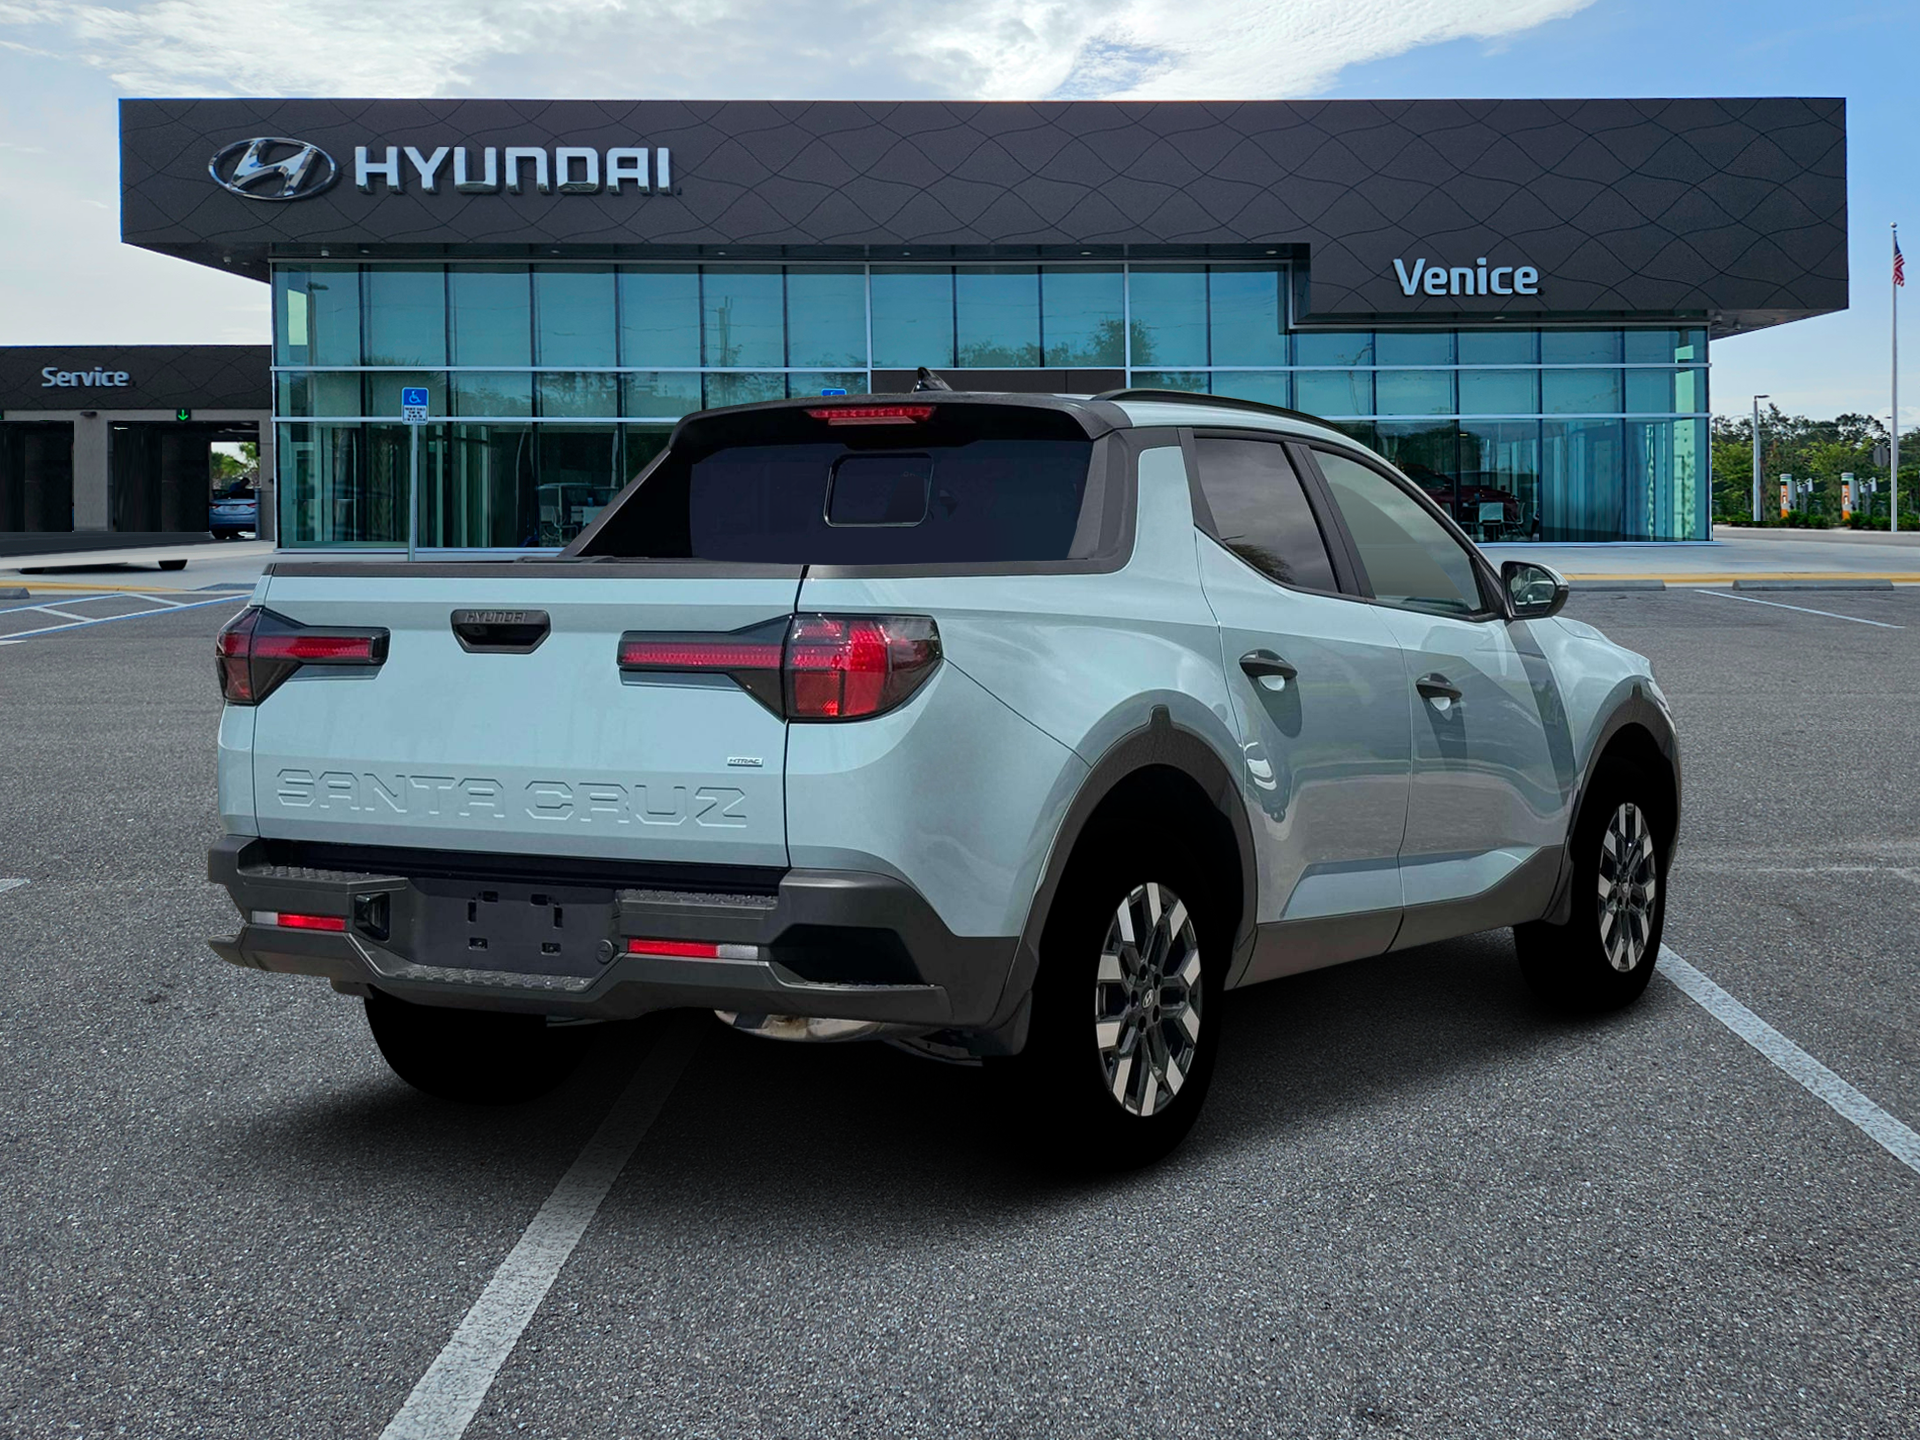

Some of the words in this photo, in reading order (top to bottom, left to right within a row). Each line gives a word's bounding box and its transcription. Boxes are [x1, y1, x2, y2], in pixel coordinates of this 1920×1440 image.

[355, 146, 670, 194] HYUNDAI
[1393, 257, 1539, 296] Venice
[41, 366, 130, 387] Service
[464, 611, 526, 624] HYUNDAI
[277, 769, 506, 818] SANTA
[525, 780, 748, 829] CRUZ
